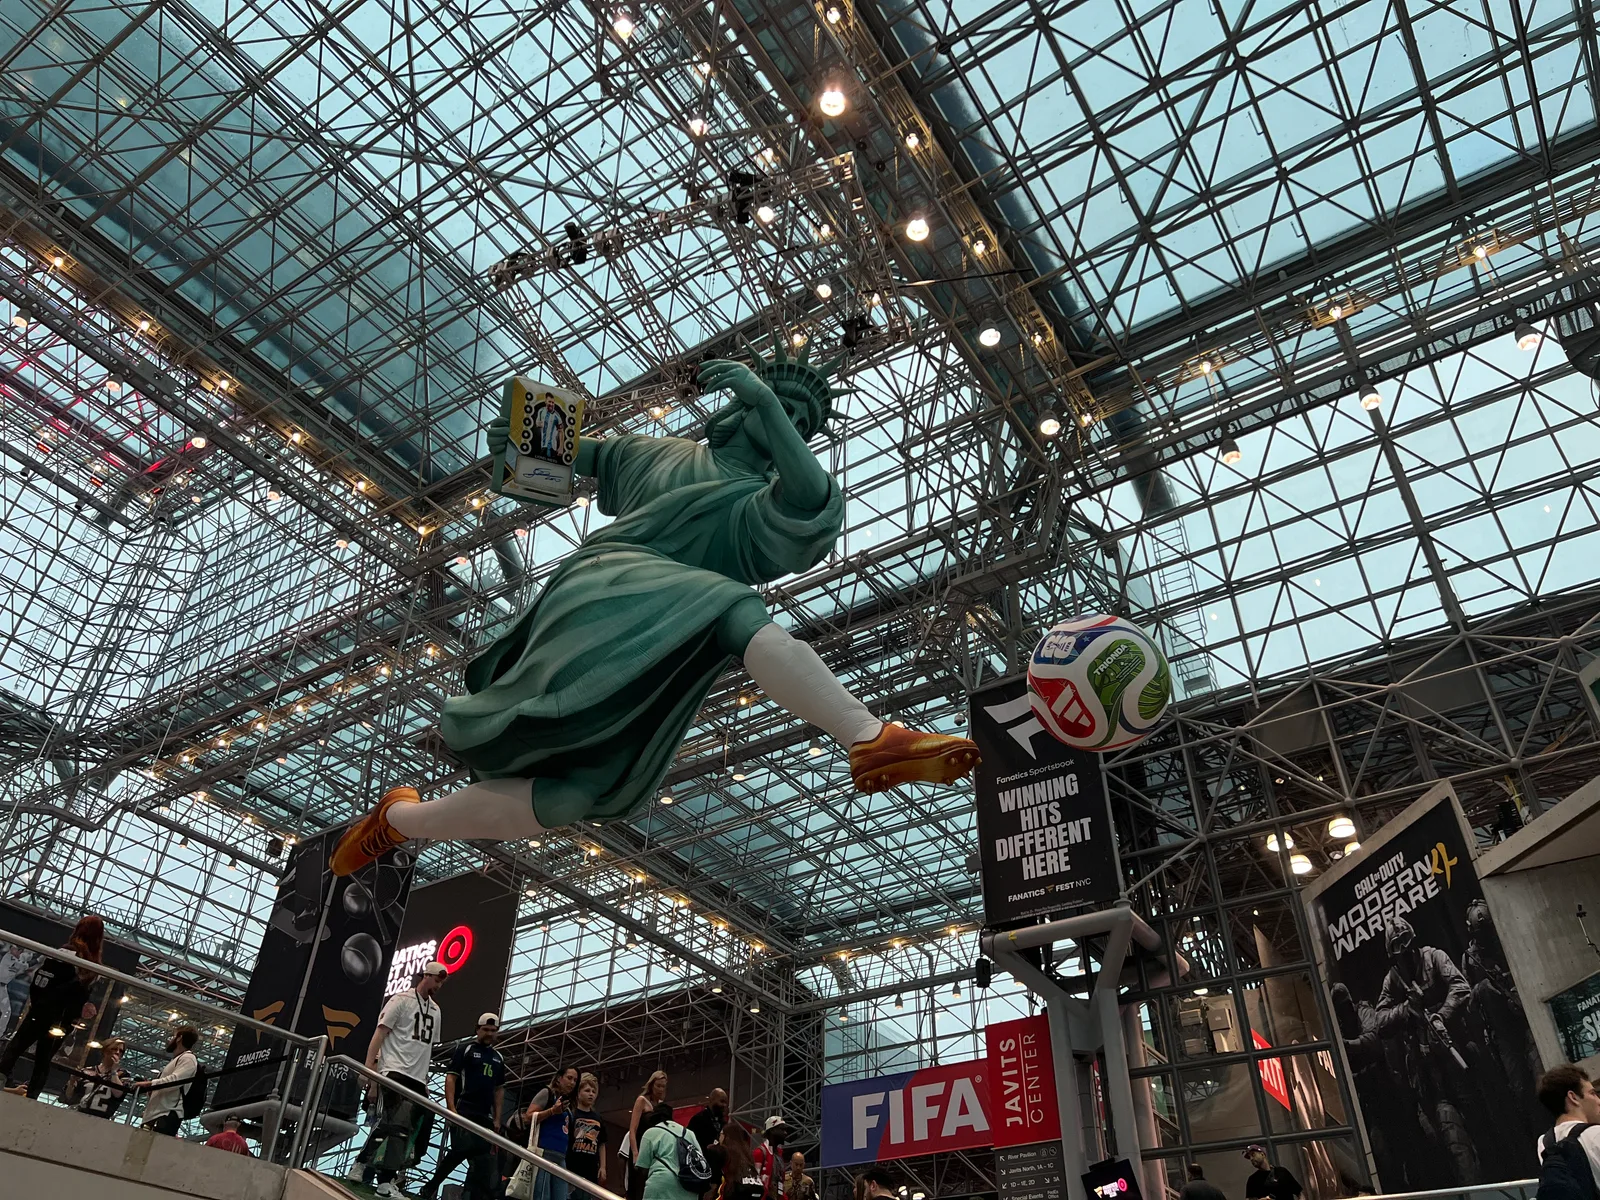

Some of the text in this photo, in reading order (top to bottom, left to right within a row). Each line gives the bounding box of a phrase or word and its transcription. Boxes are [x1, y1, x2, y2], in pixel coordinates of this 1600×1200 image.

[1093, 643, 1128, 676] TRIONDA
[996, 758, 1075, 785] Fanatics Sportsbook
[998, 775, 1079, 813] WINNING
[1019, 802, 1062, 832] HITS
[995, 817, 1092, 862] DIFFERENT
[1022, 848, 1071, 881] HERE
[1353, 851, 1405, 900] CALL OF DUTY
[1008, 877, 1092, 903] FANATICS FEST NYC
[1327, 854, 1432, 943] MODERN
[1333, 877, 1439, 961] WARFARE
[412, 1012, 434, 1044] 13
[236, 1048, 272, 1065] FANATICS
[482, 1062, 494, 1078] 76
[329, 1067, 348, 1081] NYC
[999, 1037, 1024, 1128] JAVITS
[1025, 1032, 1045, 1124] CENTER
[79, 1082, 112, 1112] 12
[851, 1079, 991, 1150] FIFA
